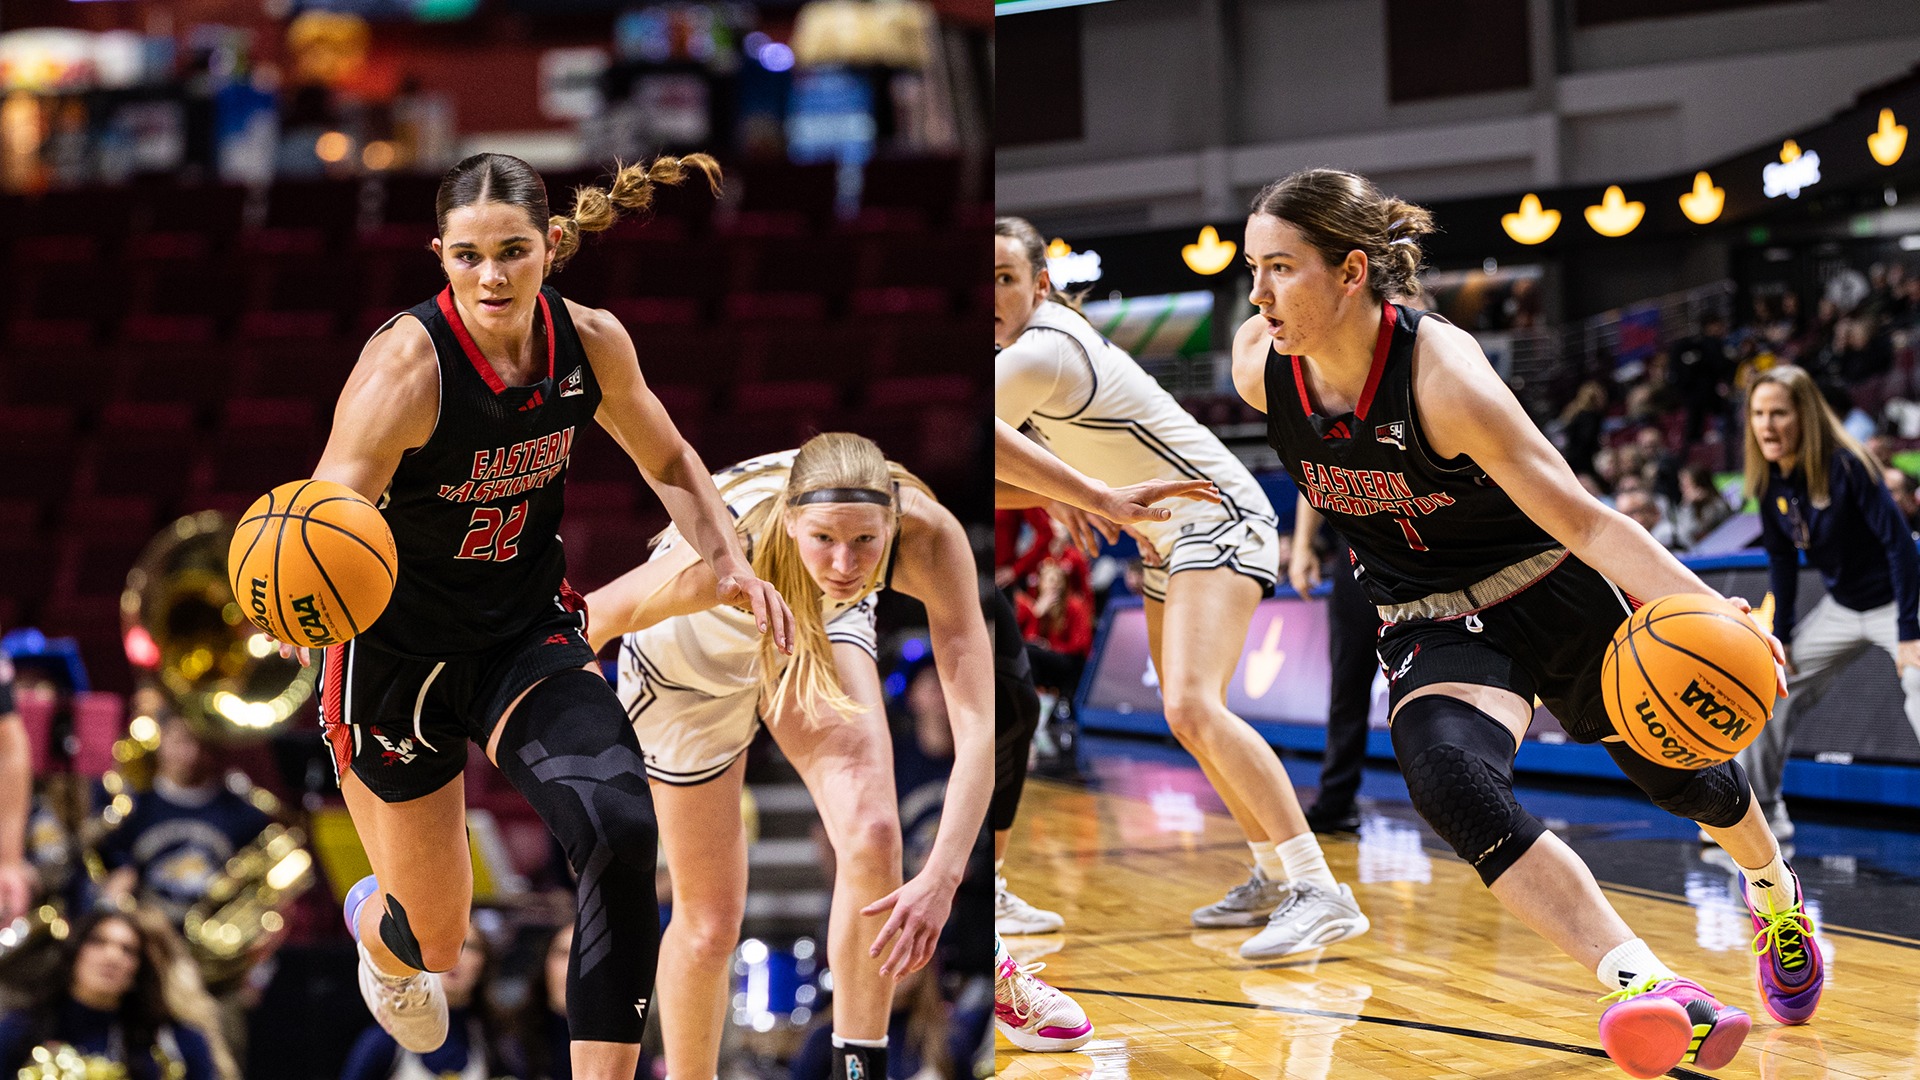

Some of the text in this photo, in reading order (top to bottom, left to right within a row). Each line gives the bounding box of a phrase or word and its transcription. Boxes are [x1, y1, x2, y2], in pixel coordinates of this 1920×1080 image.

[471, 425, 576, 480] EASTERN
[1301, 460, 1414, 500] EASTERN
[453, 499, 529, 562] 22
[1393, 518, 1430, 551] 1
[291, 593, 339, 647] NCAA
[1680, 679, 1752, 743] NCAA
